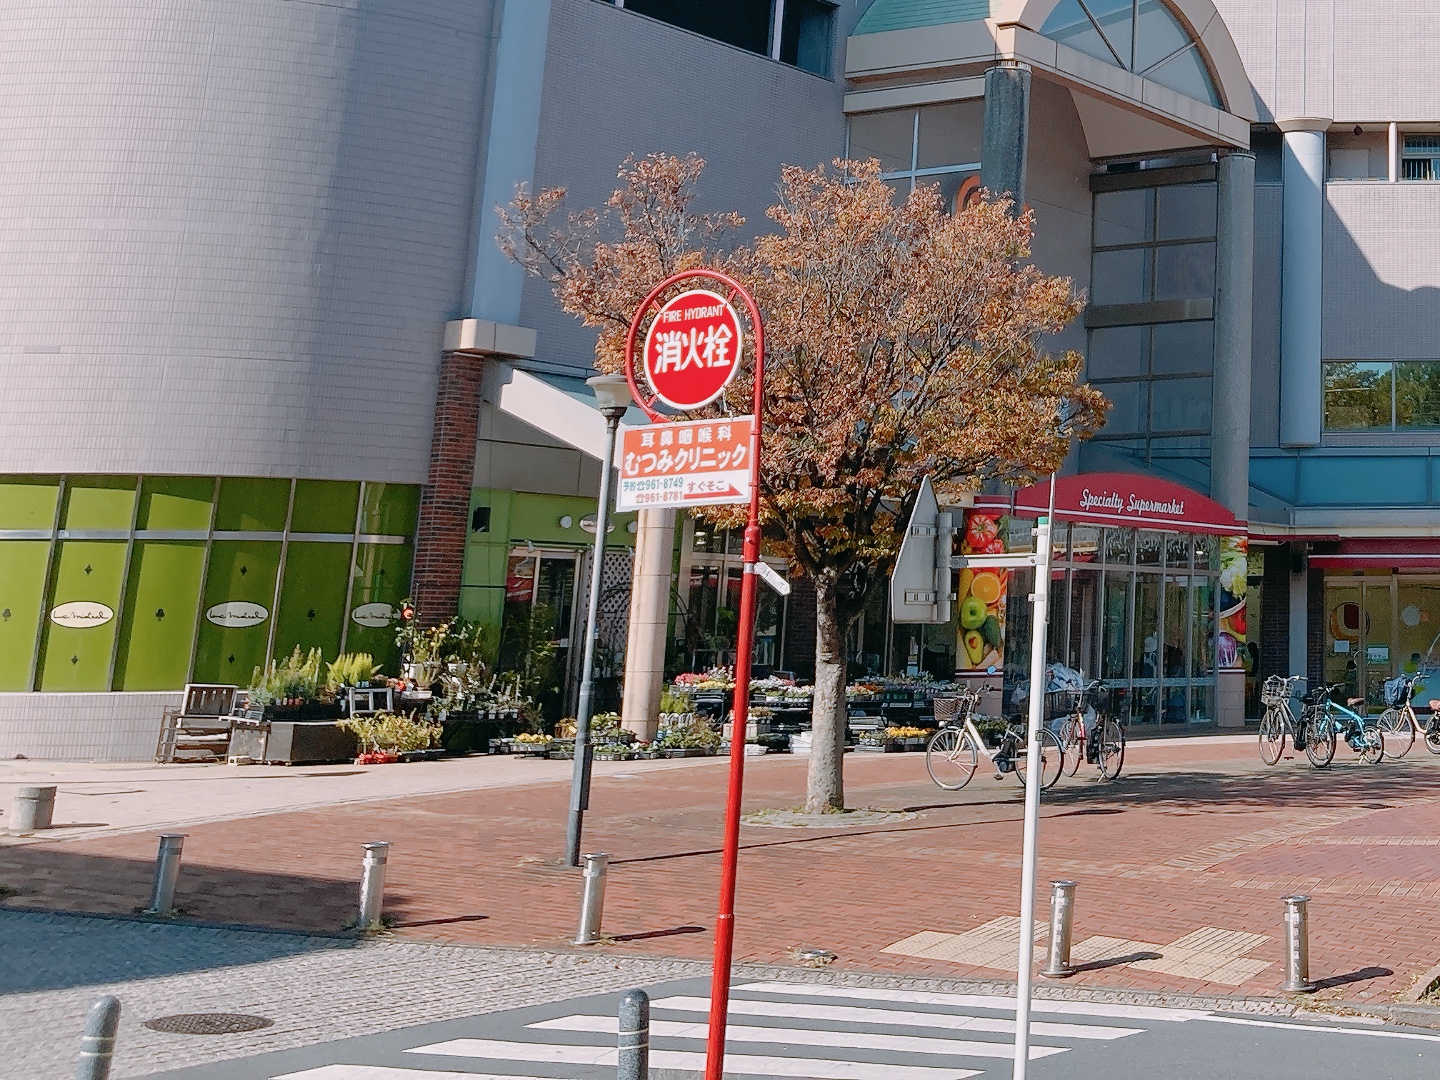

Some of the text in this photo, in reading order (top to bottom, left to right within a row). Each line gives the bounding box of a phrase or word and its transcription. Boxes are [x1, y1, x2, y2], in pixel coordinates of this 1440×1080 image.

[662, 304, 725, 324] FIRE HYDRANT
[653, 322, 733, 375] 消火栓
[640, 424, 733, 448] 耳鼻咽喉科
[624, 442, 748, 476] むつみクリニック
[686, 480, 726, 494] すぐそこ
[1079, 487, 1185, 516] Specialty Supermarket
